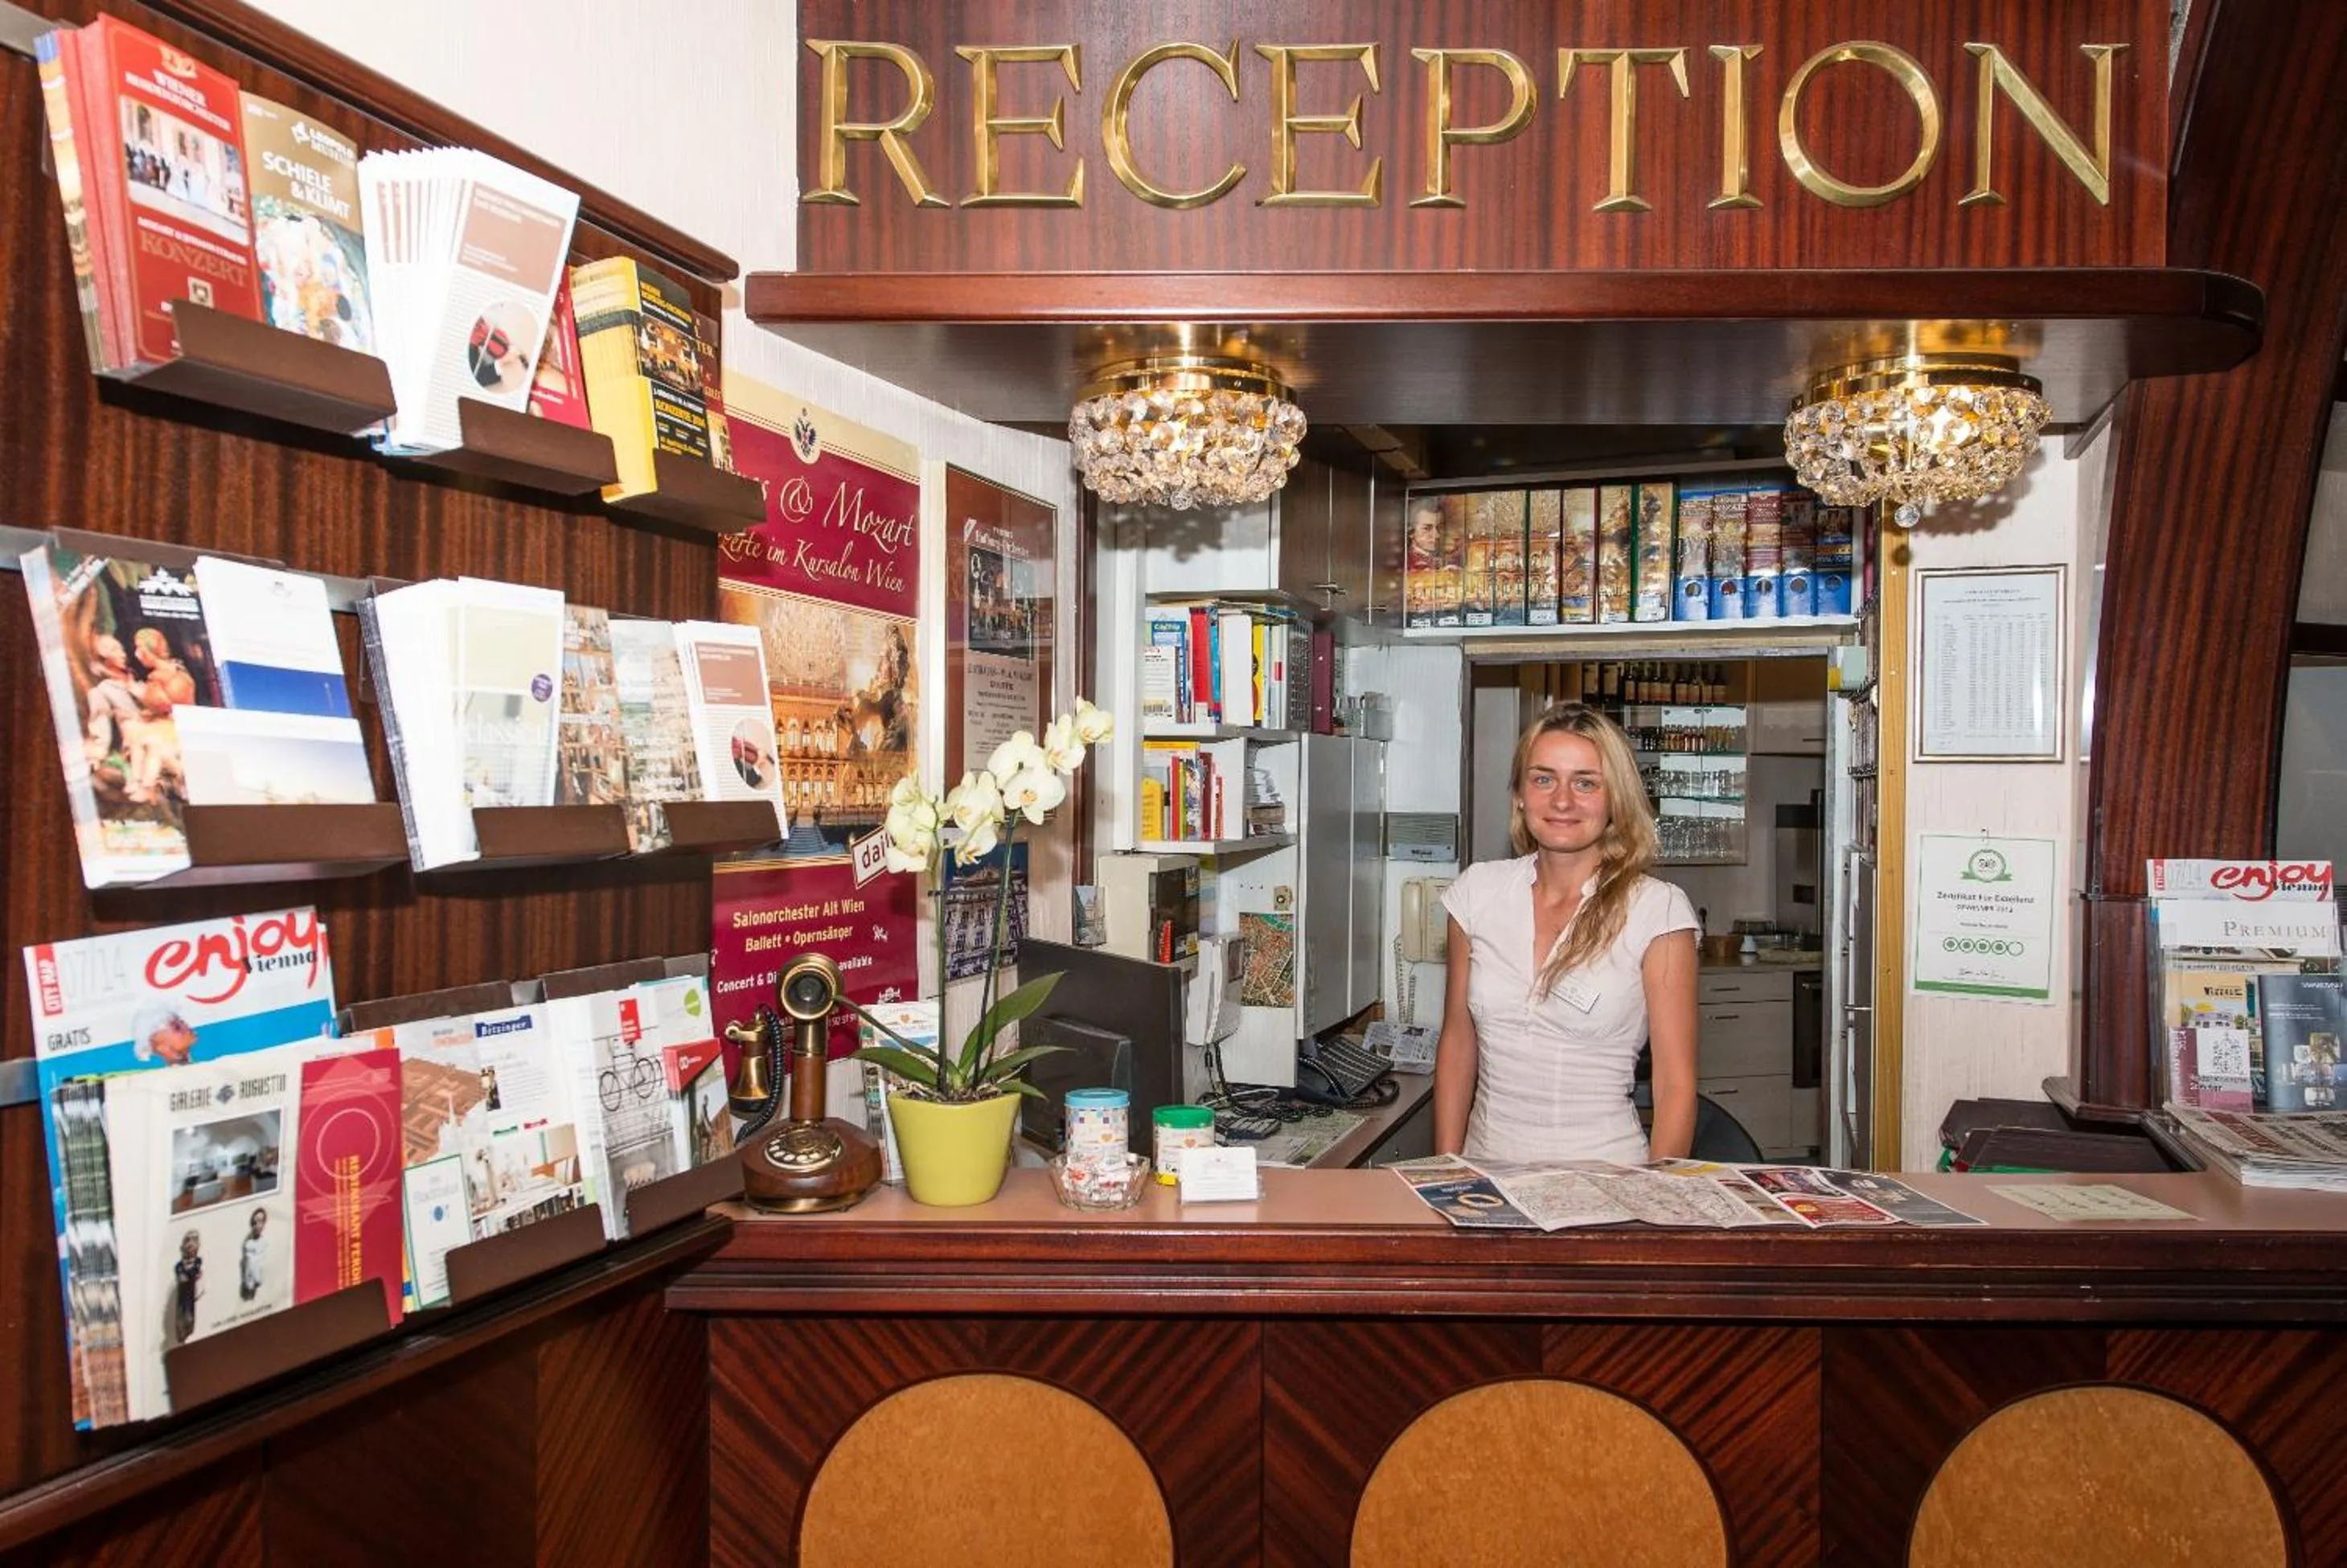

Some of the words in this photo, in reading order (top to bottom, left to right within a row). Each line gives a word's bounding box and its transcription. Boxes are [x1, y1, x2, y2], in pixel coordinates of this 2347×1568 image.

[805, 39, 2129, 211] RECEPTION
[262, 150, 331, 193] SCHIELE
[290, 180, 305, 200] &
[306, 185, 351, 221] KLIMT
[140, 230, 248, 287] KONZERT
[780, 477, 813, 523] &
[823, 482, 915, 553] Mozart
[720, 529, 763, 562] zerte
[767, 536, 787, 566] im
[793, 539, 860, 581] Kursalon
[866, 558, 905, 593] Wien
[2210, 860, 2333, 902] enjoy
[732, 904, 820, 928] Salonorchester
[823, 901, 839, 917] Alt
[841, 898, 864, 913] Wien
[143, 909, 318, 1004] enjoy
[745, 934, 782, 952] Ballett
[793, 926, 854, 947] Opernsänger
[243, 950, 318, 975] Vienna
[717, 975, 754, 993] Concert
[757, 973, 765, 985] &
[766, 971, 778, 984] Di
[838, 955, 873, 971] available
[47, 1026, 91, 1051] GRATIS
[349, 1154, 361, 1238] RESTAURANT
